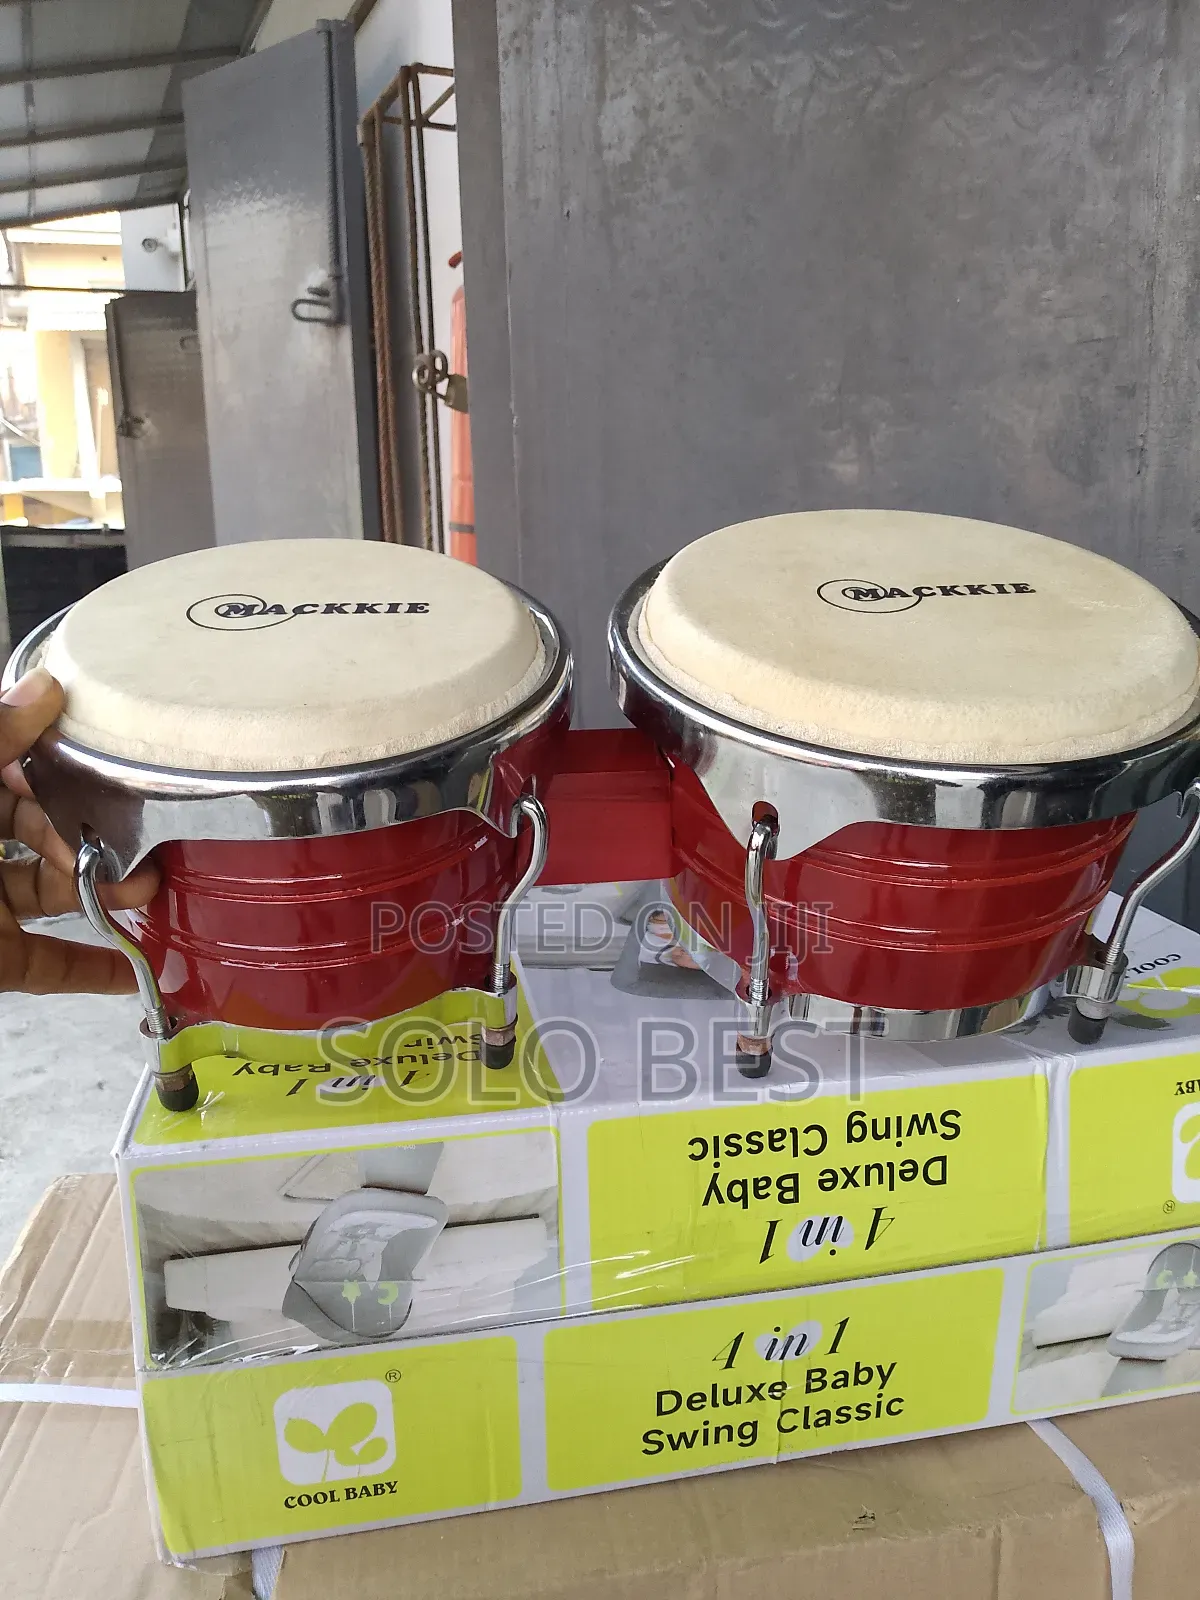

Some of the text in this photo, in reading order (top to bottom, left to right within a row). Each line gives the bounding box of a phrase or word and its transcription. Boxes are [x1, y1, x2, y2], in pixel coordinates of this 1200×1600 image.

[350, 1048, 481, 1069] Deluxe
[688, 1109, 962, 1168] Swing Classic
[702, 1155, 948, 1209] Deluxe Baby
[759, 1206, 895, 1264] 4 in 1
[712, 1316, 850, 1371] 4 in 1
[656, 1361, 897, 1417] Deluxe Baby
[641, 1392, 905, 1456] Swing Classic
[284, 1480, 398, 1509] COOL BABY
